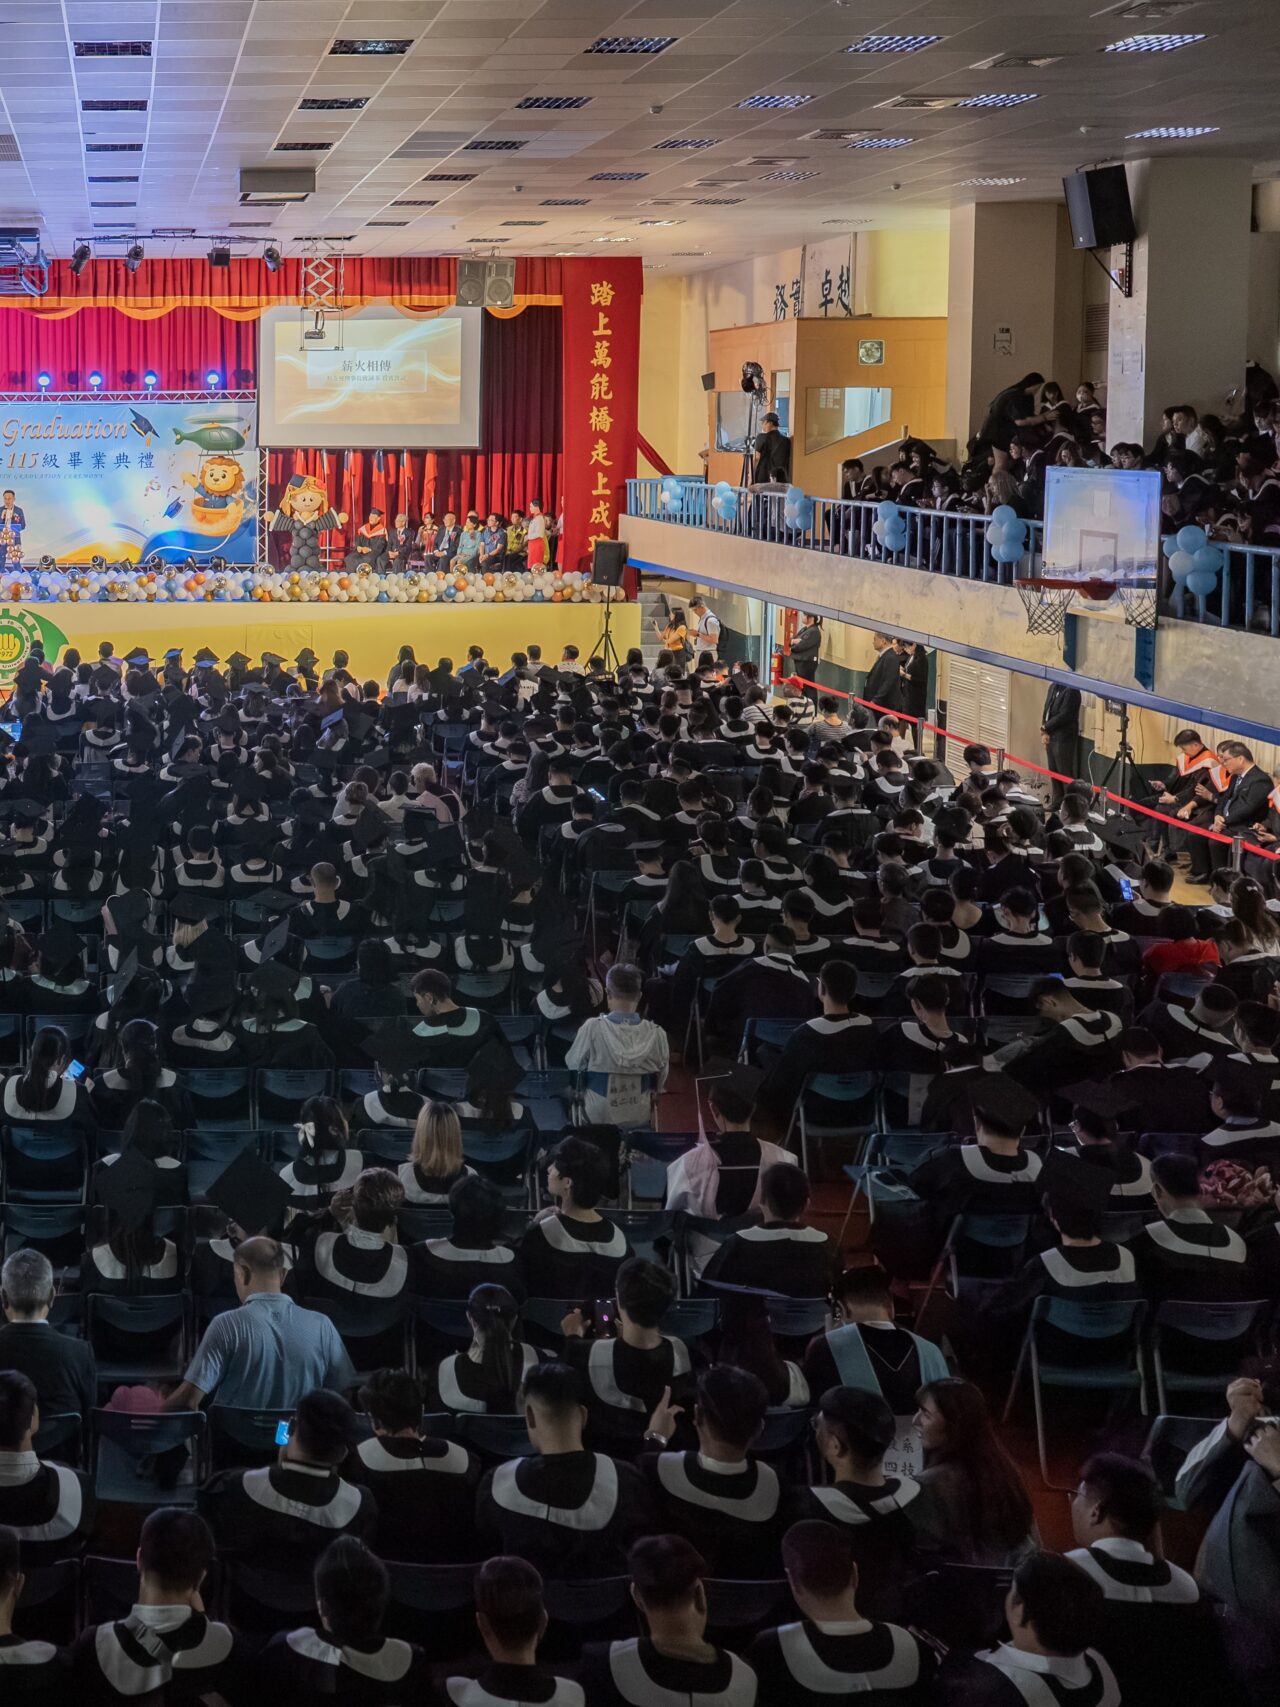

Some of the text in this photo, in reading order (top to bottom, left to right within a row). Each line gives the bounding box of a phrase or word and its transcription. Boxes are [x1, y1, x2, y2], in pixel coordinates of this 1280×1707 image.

[818, 264, 852, 318] 卓越
[341, 359, 392, 373] 薪火相傳
[2, 416, 128, 447] Graduation
